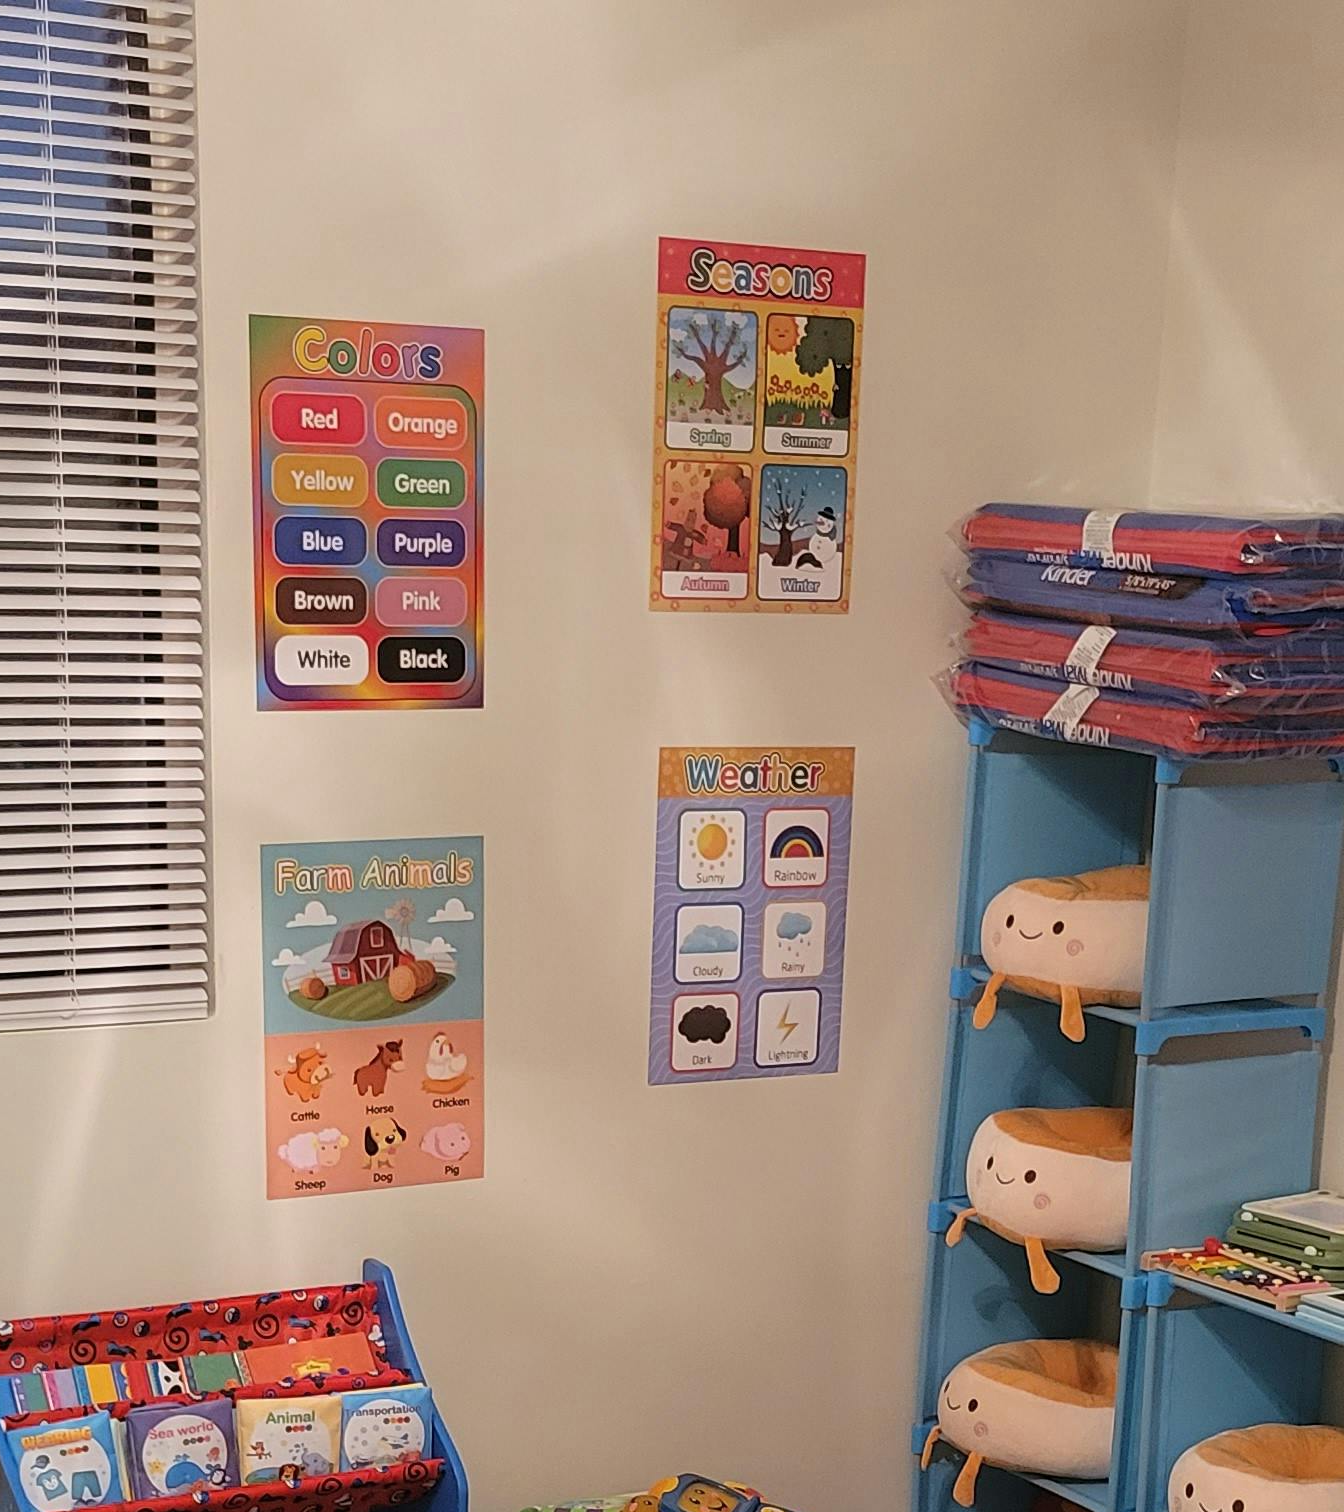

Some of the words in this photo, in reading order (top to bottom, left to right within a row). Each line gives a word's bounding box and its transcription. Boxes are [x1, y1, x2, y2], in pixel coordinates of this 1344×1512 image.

[686, 247, 833, 301] Seasons
[293, 325, 442, 381] Colors
[301, 408, 338, 429] Red
[388, 412, 457, 438] Orange
[690, 429, 731, 447] Spring
[782, 433, 832, 448] Summer
[291, 471, 354, 491] Yellow
[395, 474, 450, 494] Green
[302, 530, 343, 551] Blue
[395, 533, 453, 557] Purple
[681, 576, 729, 591] Autumn
[1041, 565, 1096, 586] Kinder
[781, 578, 820, 593] Winter
[294, 591, 353, 610] Brown
[403, 591, 440, 611] Pink
[298, 650, 351, 668] White
[400, 649, 448, 669] Black
[685, 752, 825, 793] Weather
[274, 857, 354, 896] Farm
[360, 850, 474, 890] Animals
[697, 873, 725, 884] Sunny
[774, 870, 816, 881] Rainbow
[693, 966, 723, 977] Cloudy
[781, 963, 805, 973] Rainy
[692, 1056, 712, 1065] Dark
[768, 1050, 808, 1060] Lightning
[366, 1105, 393, 1115] Horse
[432, 1097, 469, 1108] Chicken
[291, 1111, 320, 1122] Cattle
[374, 1173, 392, 1183] Dog
[445, 1165, 459, 1176] Pig
[295, 1180, 326, 1190] Sheep
[266, 1411, 315, 1424] Animal
[346, 1405, 421, 1417] Transportation
[149, 1427, 173, 1440] Sea
[178, 1420, 214, 1436] world
